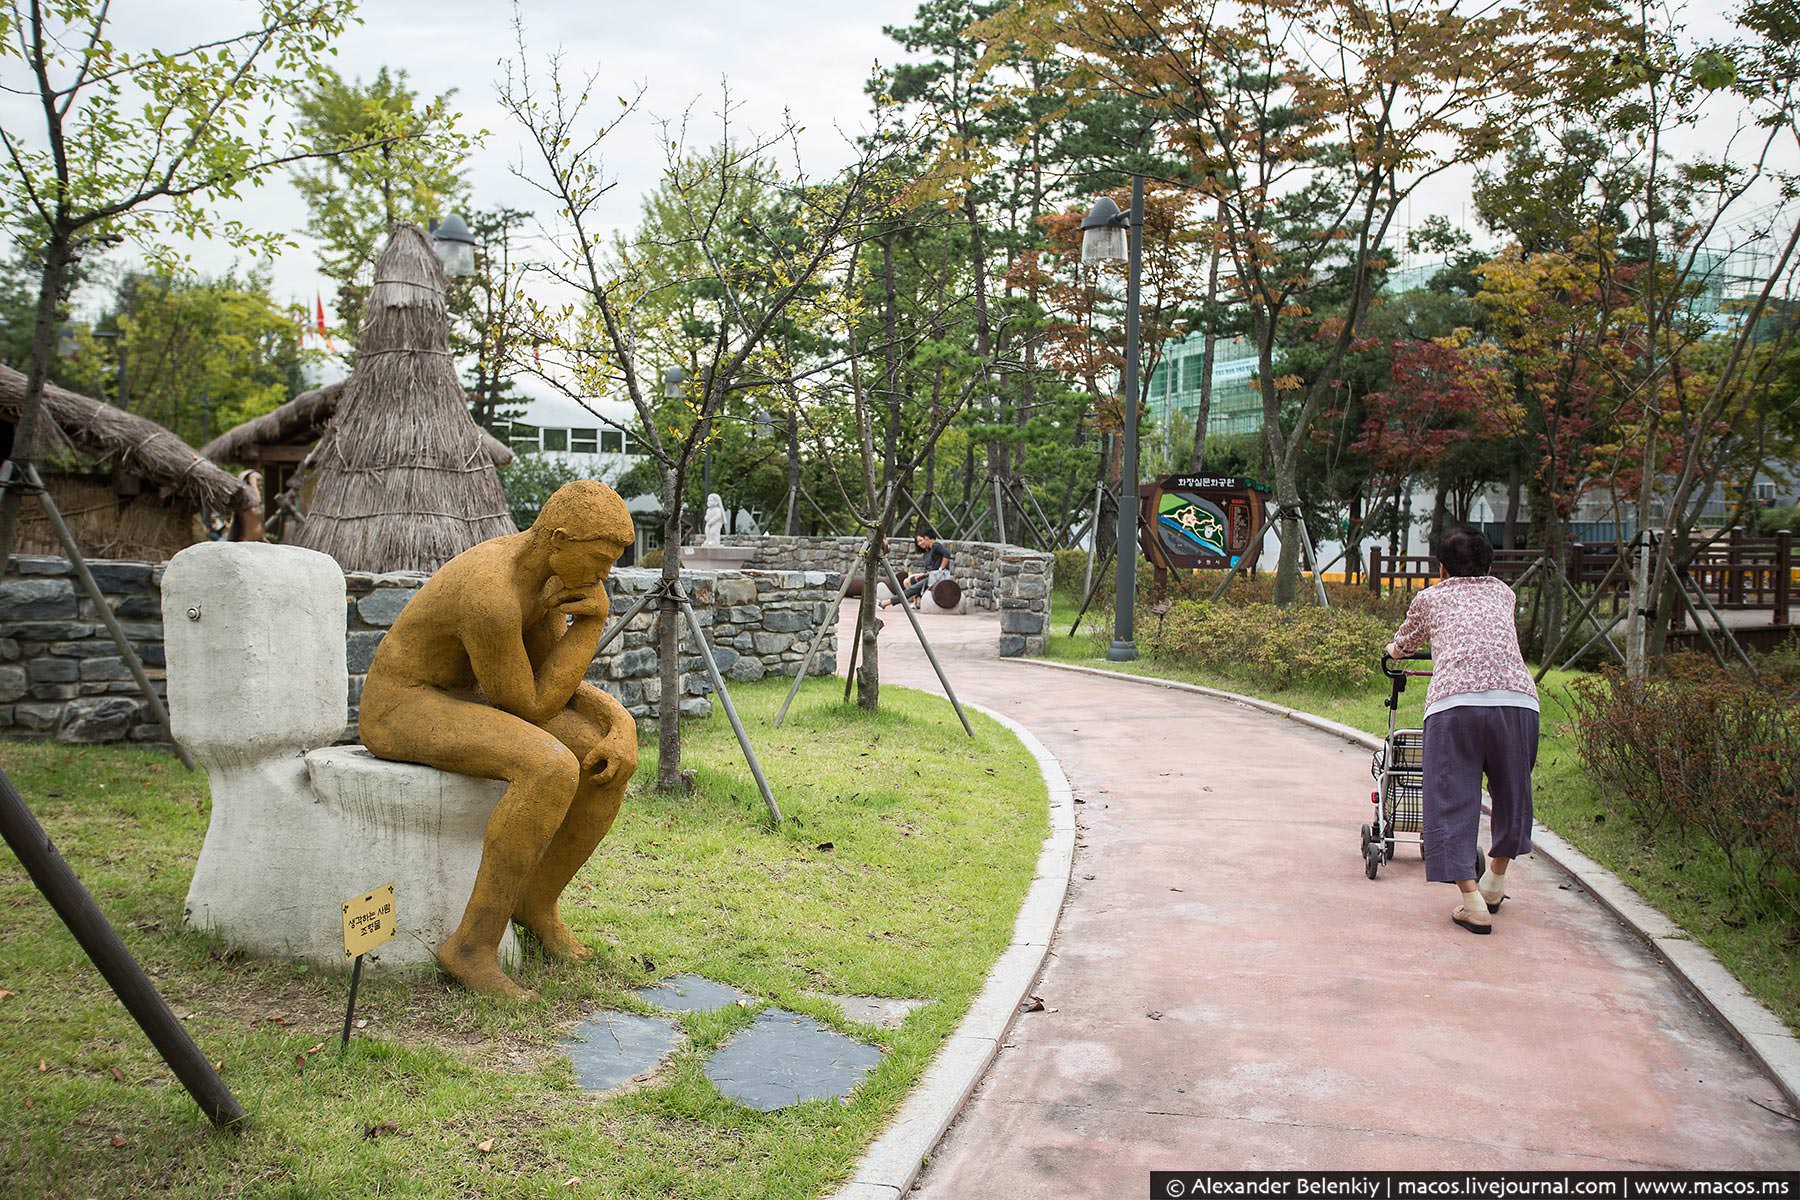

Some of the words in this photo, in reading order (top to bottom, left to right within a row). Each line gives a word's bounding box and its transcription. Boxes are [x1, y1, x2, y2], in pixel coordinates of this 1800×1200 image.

[349, 911, 376, 929] 생각하는
[377, 903, 391, 916] 사람
[360, 920, 381, 936] 조형물
